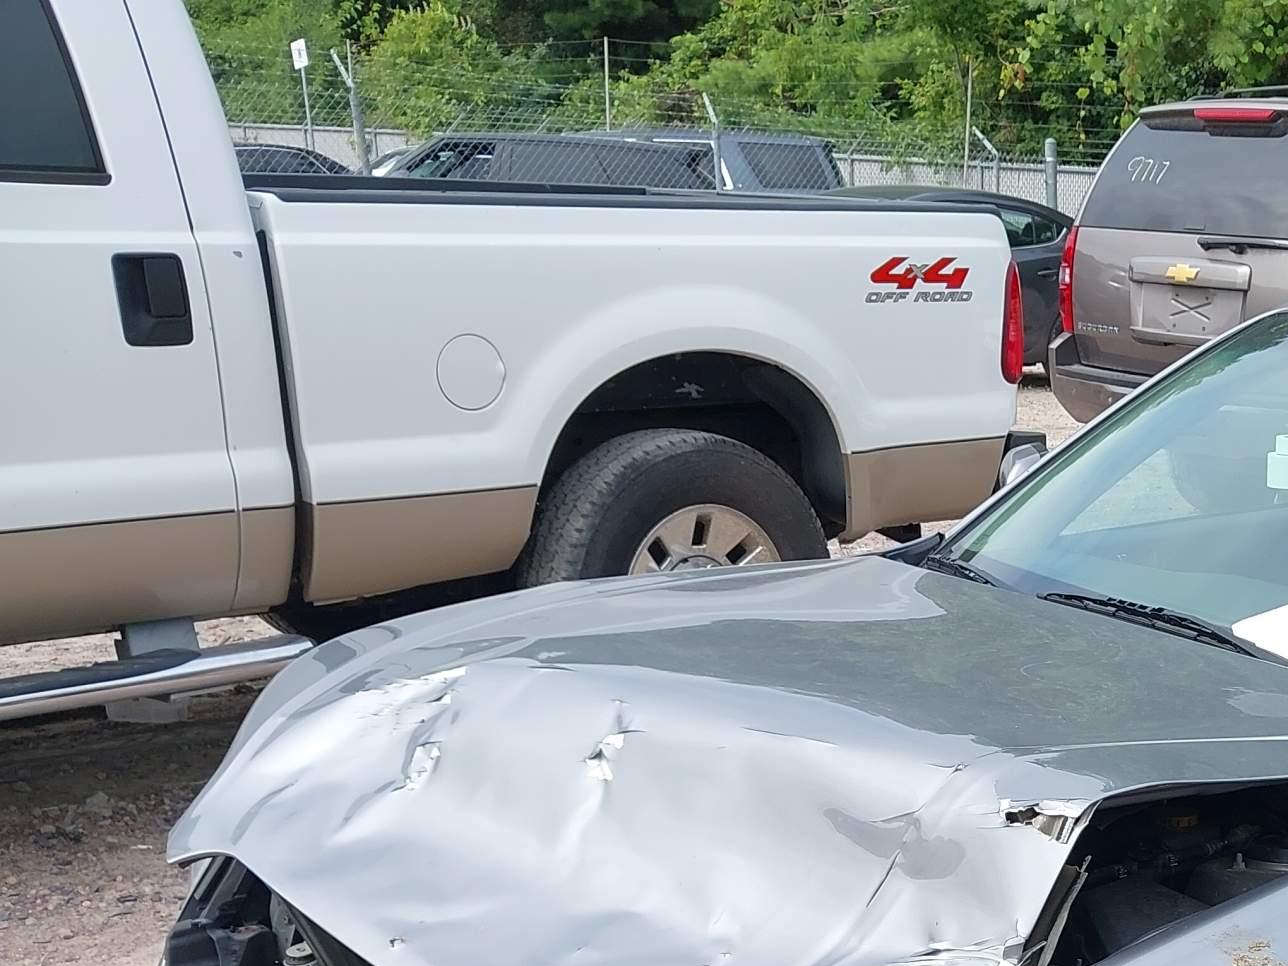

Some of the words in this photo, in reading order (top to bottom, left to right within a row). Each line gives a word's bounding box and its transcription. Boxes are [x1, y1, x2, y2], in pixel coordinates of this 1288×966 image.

[1127, 156, 1170, 184] 9717
[864, 291, 910, 304] OFF
[912, 290, 974, 303] ROAD
